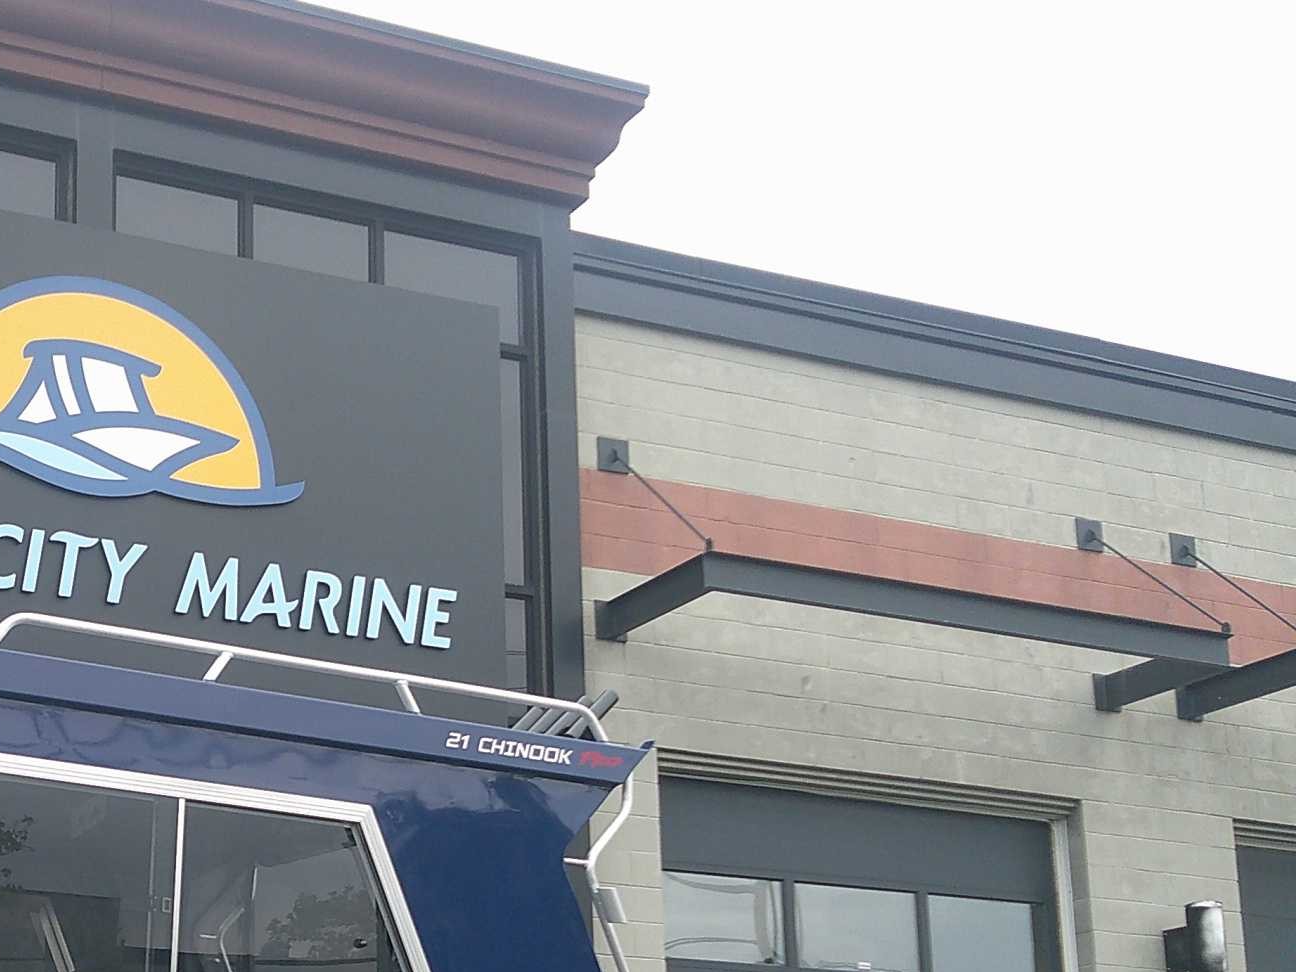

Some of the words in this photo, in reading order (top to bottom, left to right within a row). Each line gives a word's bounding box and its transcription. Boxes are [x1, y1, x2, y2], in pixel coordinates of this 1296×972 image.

[175, 551, 458, 648] MARINE
[446, 732, 470, 750] 21
[478, 737, 573, 765] CHINOOK
